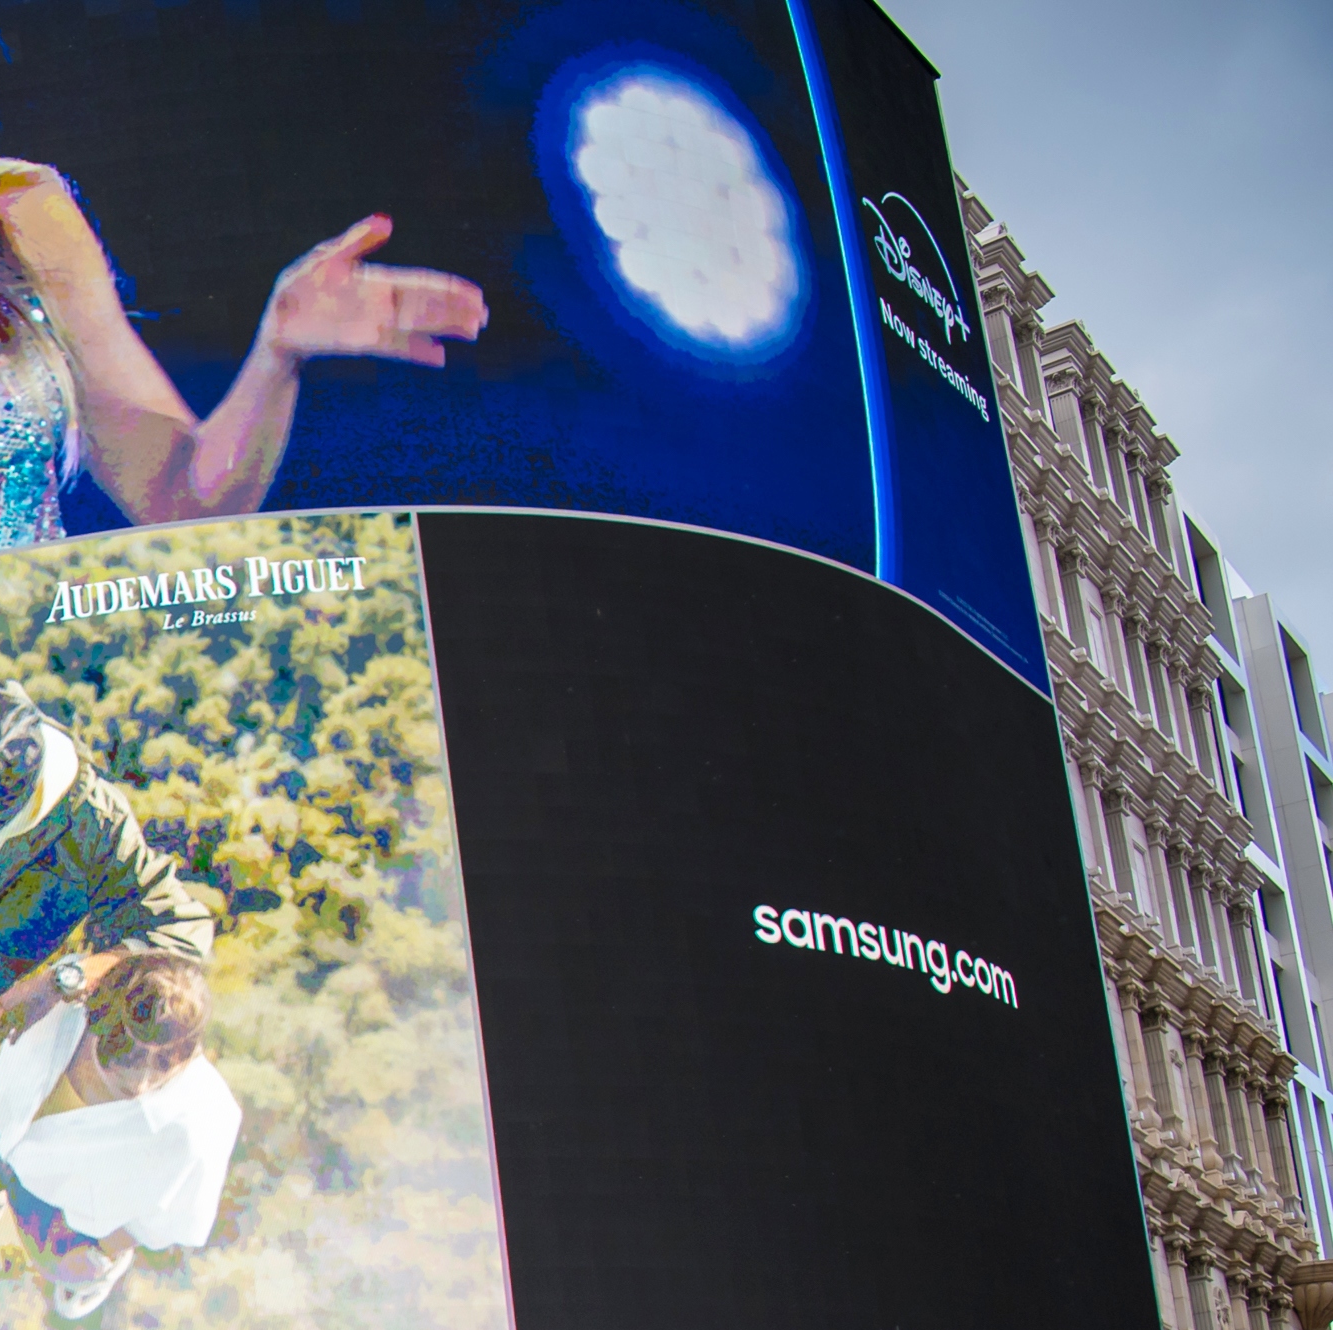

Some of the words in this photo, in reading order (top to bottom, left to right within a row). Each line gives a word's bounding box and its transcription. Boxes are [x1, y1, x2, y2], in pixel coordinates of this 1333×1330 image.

[879, 297, 916, 349] Now
[917, 338, 990, 422] streaming
[44, 564, 238, 624] AUDEMARS
[244, 555, 367, 598] PIGUET
[162, 613, 185, 630] Le
[190, 608, 258, 627] Brassus
[754, 903, 1019, 1010] samsung.com
